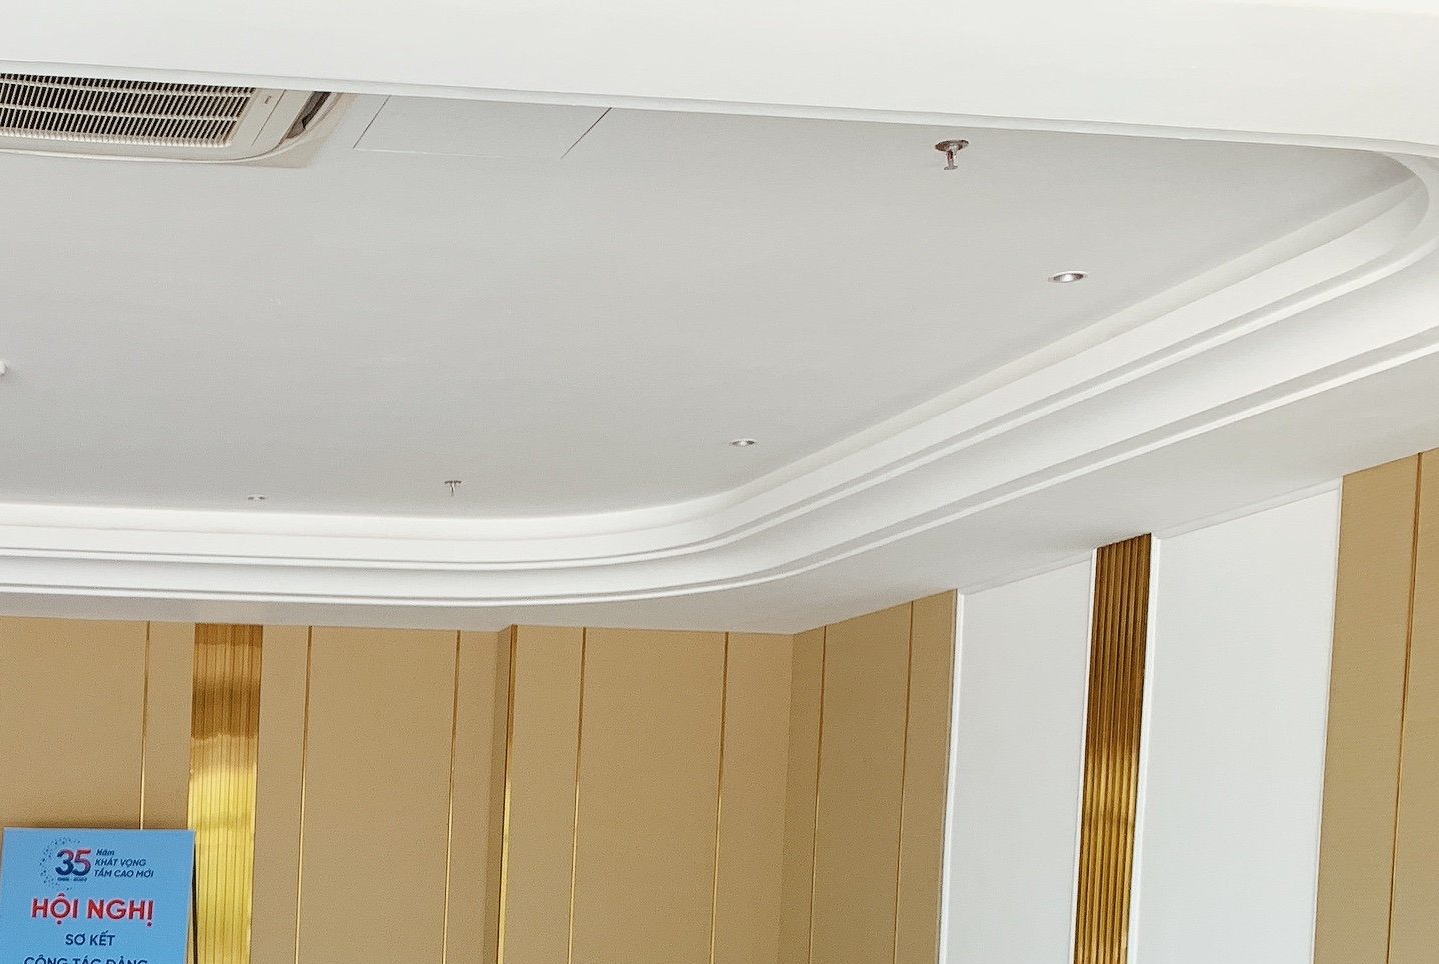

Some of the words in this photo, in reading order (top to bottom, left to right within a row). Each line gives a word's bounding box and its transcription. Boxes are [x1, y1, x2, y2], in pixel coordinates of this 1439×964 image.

[55, 848, 92, 876] 35
[95, 857, 118, 867] KHÁT
[120, 858, 147, 868] VỌNG
[114, 869, 134, 878] CAO
[31, 892, 79, 925] HỘI
[87, 899, 154, 927] NGHỊ
[65, 933, 86, 946] SƠ
[89, 930, 115, 947] KẾT
